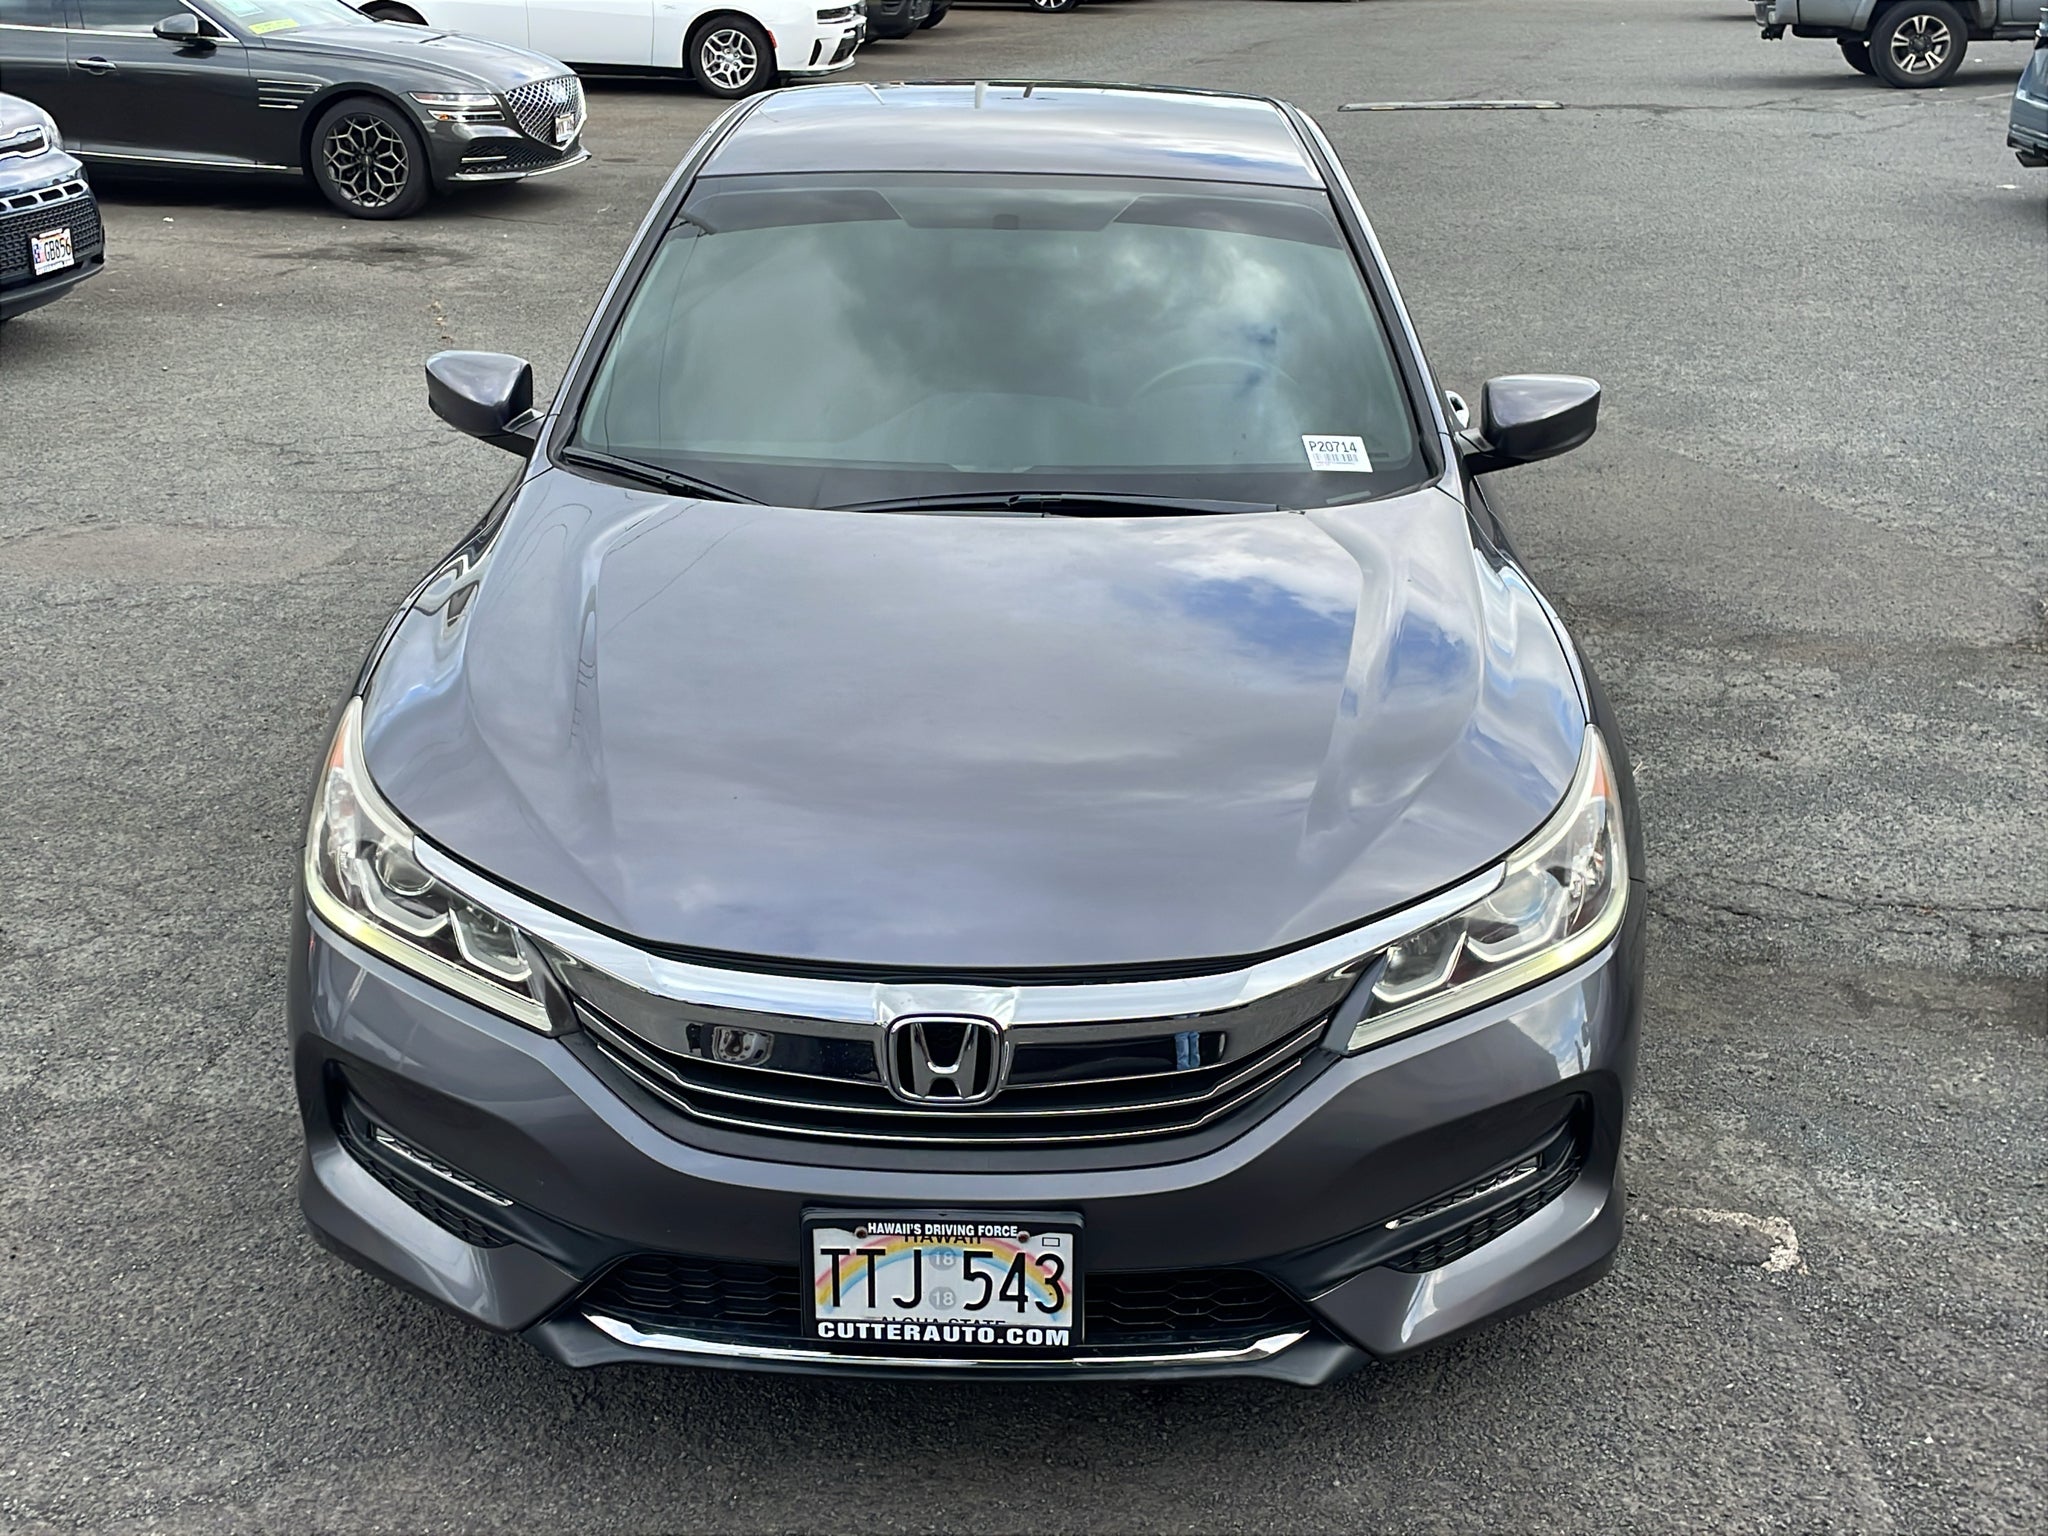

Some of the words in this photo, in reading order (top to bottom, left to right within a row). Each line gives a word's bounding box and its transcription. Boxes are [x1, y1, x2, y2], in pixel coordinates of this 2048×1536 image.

[1309, 441, 1357, 453] P20714
[867, 1222, 922, 1235] HAWAII'S
[924, 1224, 975, 1236] DRIVING
[978, 1225, 1018, 1237] FORCE
[934, 1251, 954, 1266] 18
[820, 1248, 922, 1309] TTJ
[963, 1250, 1065, 1314] 543
[932, 1291, 955, 1306] 18
[818, 1321, 1070, 1346] CUTTERAUTO.COM
